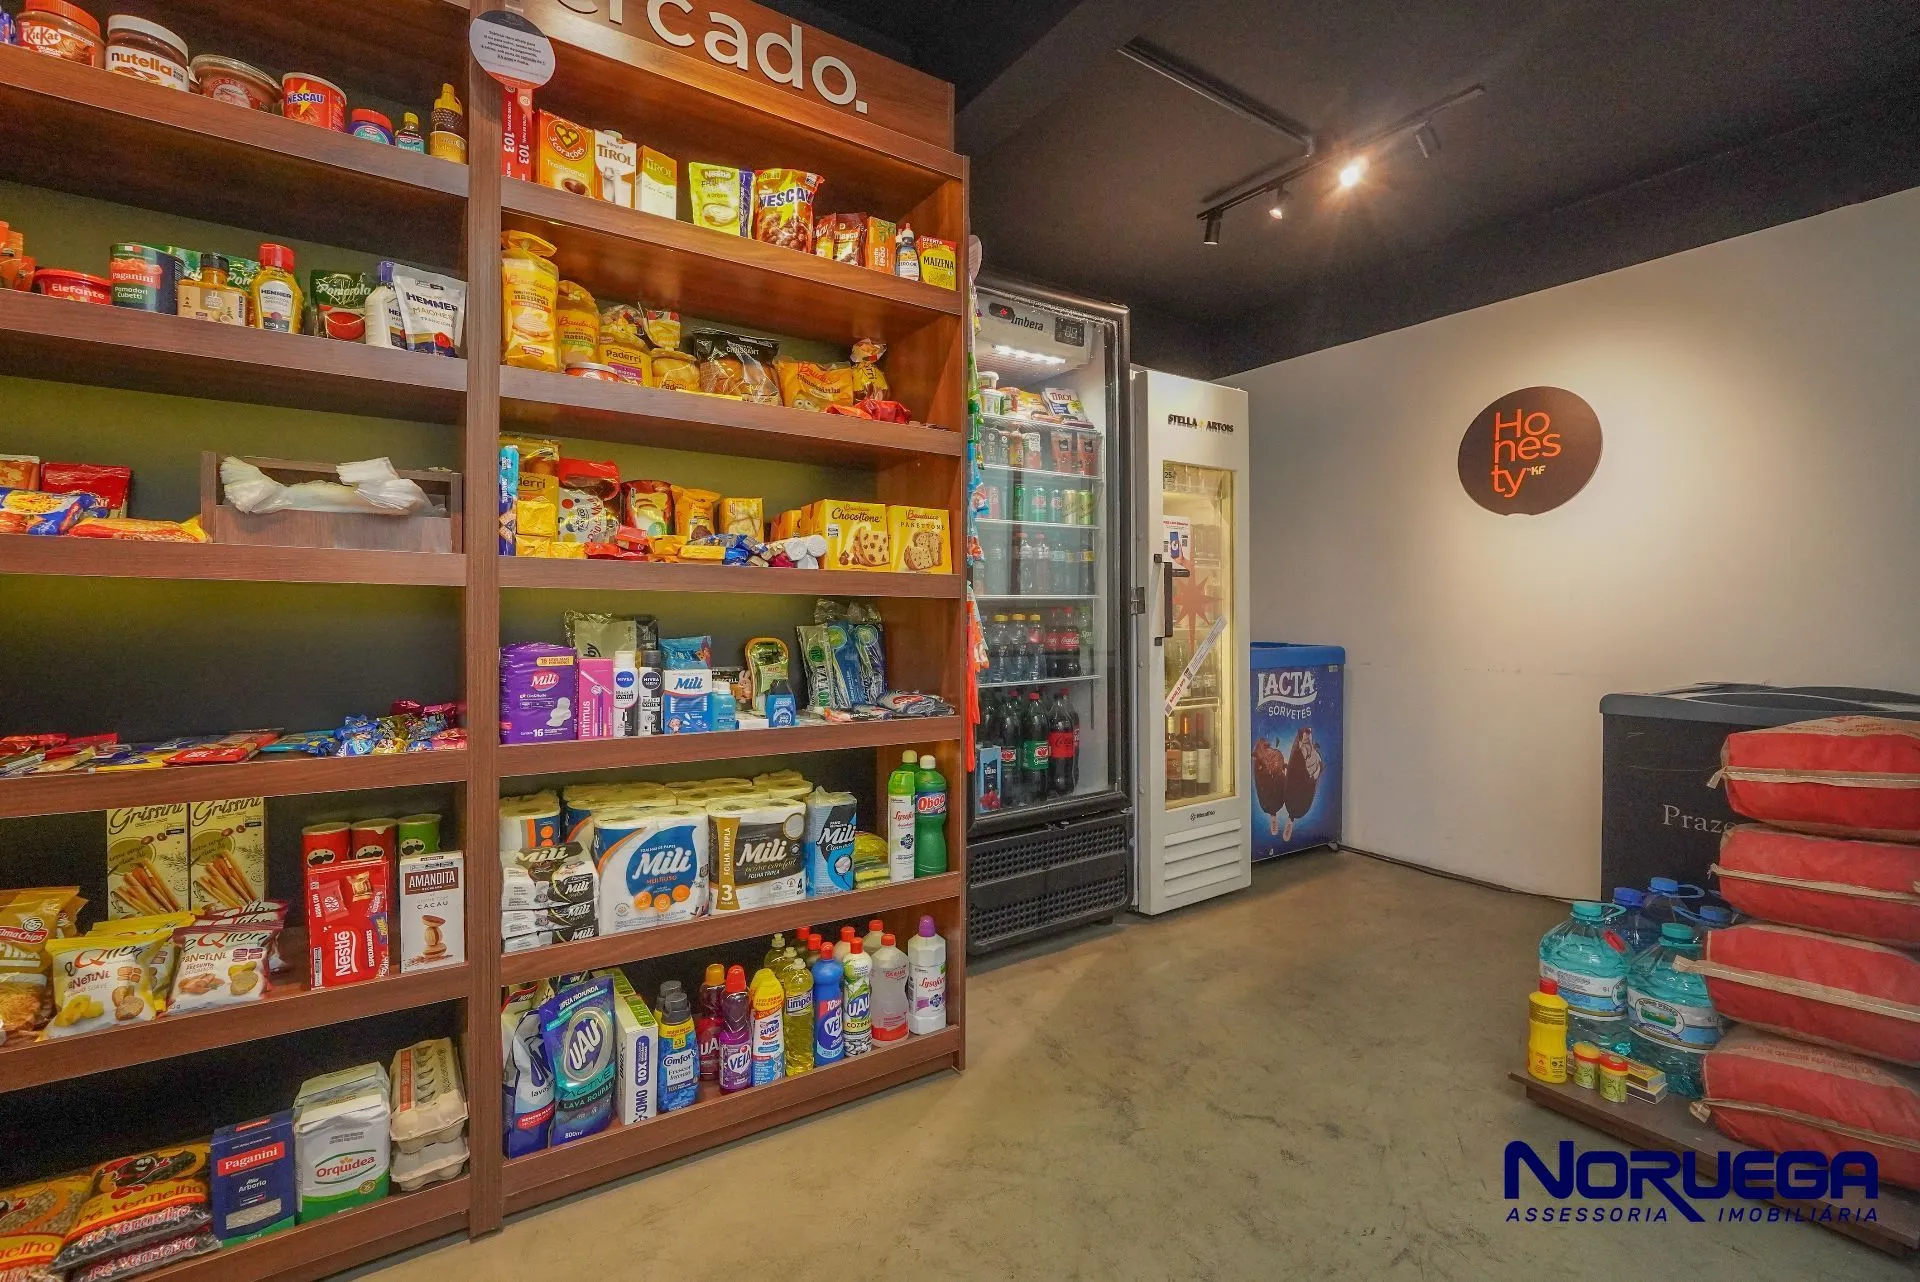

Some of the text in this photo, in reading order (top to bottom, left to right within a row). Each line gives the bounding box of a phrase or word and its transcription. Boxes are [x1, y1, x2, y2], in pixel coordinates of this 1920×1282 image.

[25, 28, 60, 45] KitKat
[111, 52, 172, 77] nutella
[287, 91, 324, 104] NESCAU
[504, 132, 514, 153] 103
[518, 145, 529, 164] 103
[596, 144, 635, 167] TIROL
[645, 157, 672, 178] TIROL
[760, 187, 815, 209] NESCAU
[923, 255, 954, 270] MAIZENA
[112, 272, 153, 284] Paganini
[52, 283, 105, 300] Elefante
[261, 288, 291, 299] HEMMER
[406, 291, 458, 312] HEMMER
[1168, 414, 1234, 433] STELLA ARTOIS
[832, 507, 881, 524] Chocottone
[906, 508, 940, 521] Bauducco
[900, 521, 945, 531] PANETTONE
[530, 673, 557, 688] Mili
[674, 676, 703, 690] Mili
[1256, 671, 1317, 708] LACTA
[1268, 705, 1312, 720] SORVETES
[533, 728, 544, 738] 16
[816, 823, 857, 846] Mili
[723, 827, 731, 876] FOLHA TRIPLA
[736, 838, 788, 867] Mili
[632, 847, 692, 880] Mili
[408, 870, 456, 889] AMANDITA
[565, 881, 590, 895] Mili
[722, 885, 733, 901] 3
[416, 901, 449, 910] CACAU
[568, 904, 591, 919] Mili
[19, 929, 44, 942] Chips
[570, 927, 594, 942] Mili
[334, 930, 351, 976] Nestlé
[787, 991, 812, 1009] Limpol
[569, 1018, 602, 1070] UAU
[663, 1049, 696, 1067] Comfort
[637, 1062, 646, 1083] 10X
[563, 1099, 587, 1110] LAVA
[635, 1089, 648, 1113] OMO
[565, 1129, 583, 1139] 800ml
[224, 1146, 278, 1171] Paganini
[238, 1179, 267, 1193] Arborio
[111, 1183, 203, 1213] Vermelho
